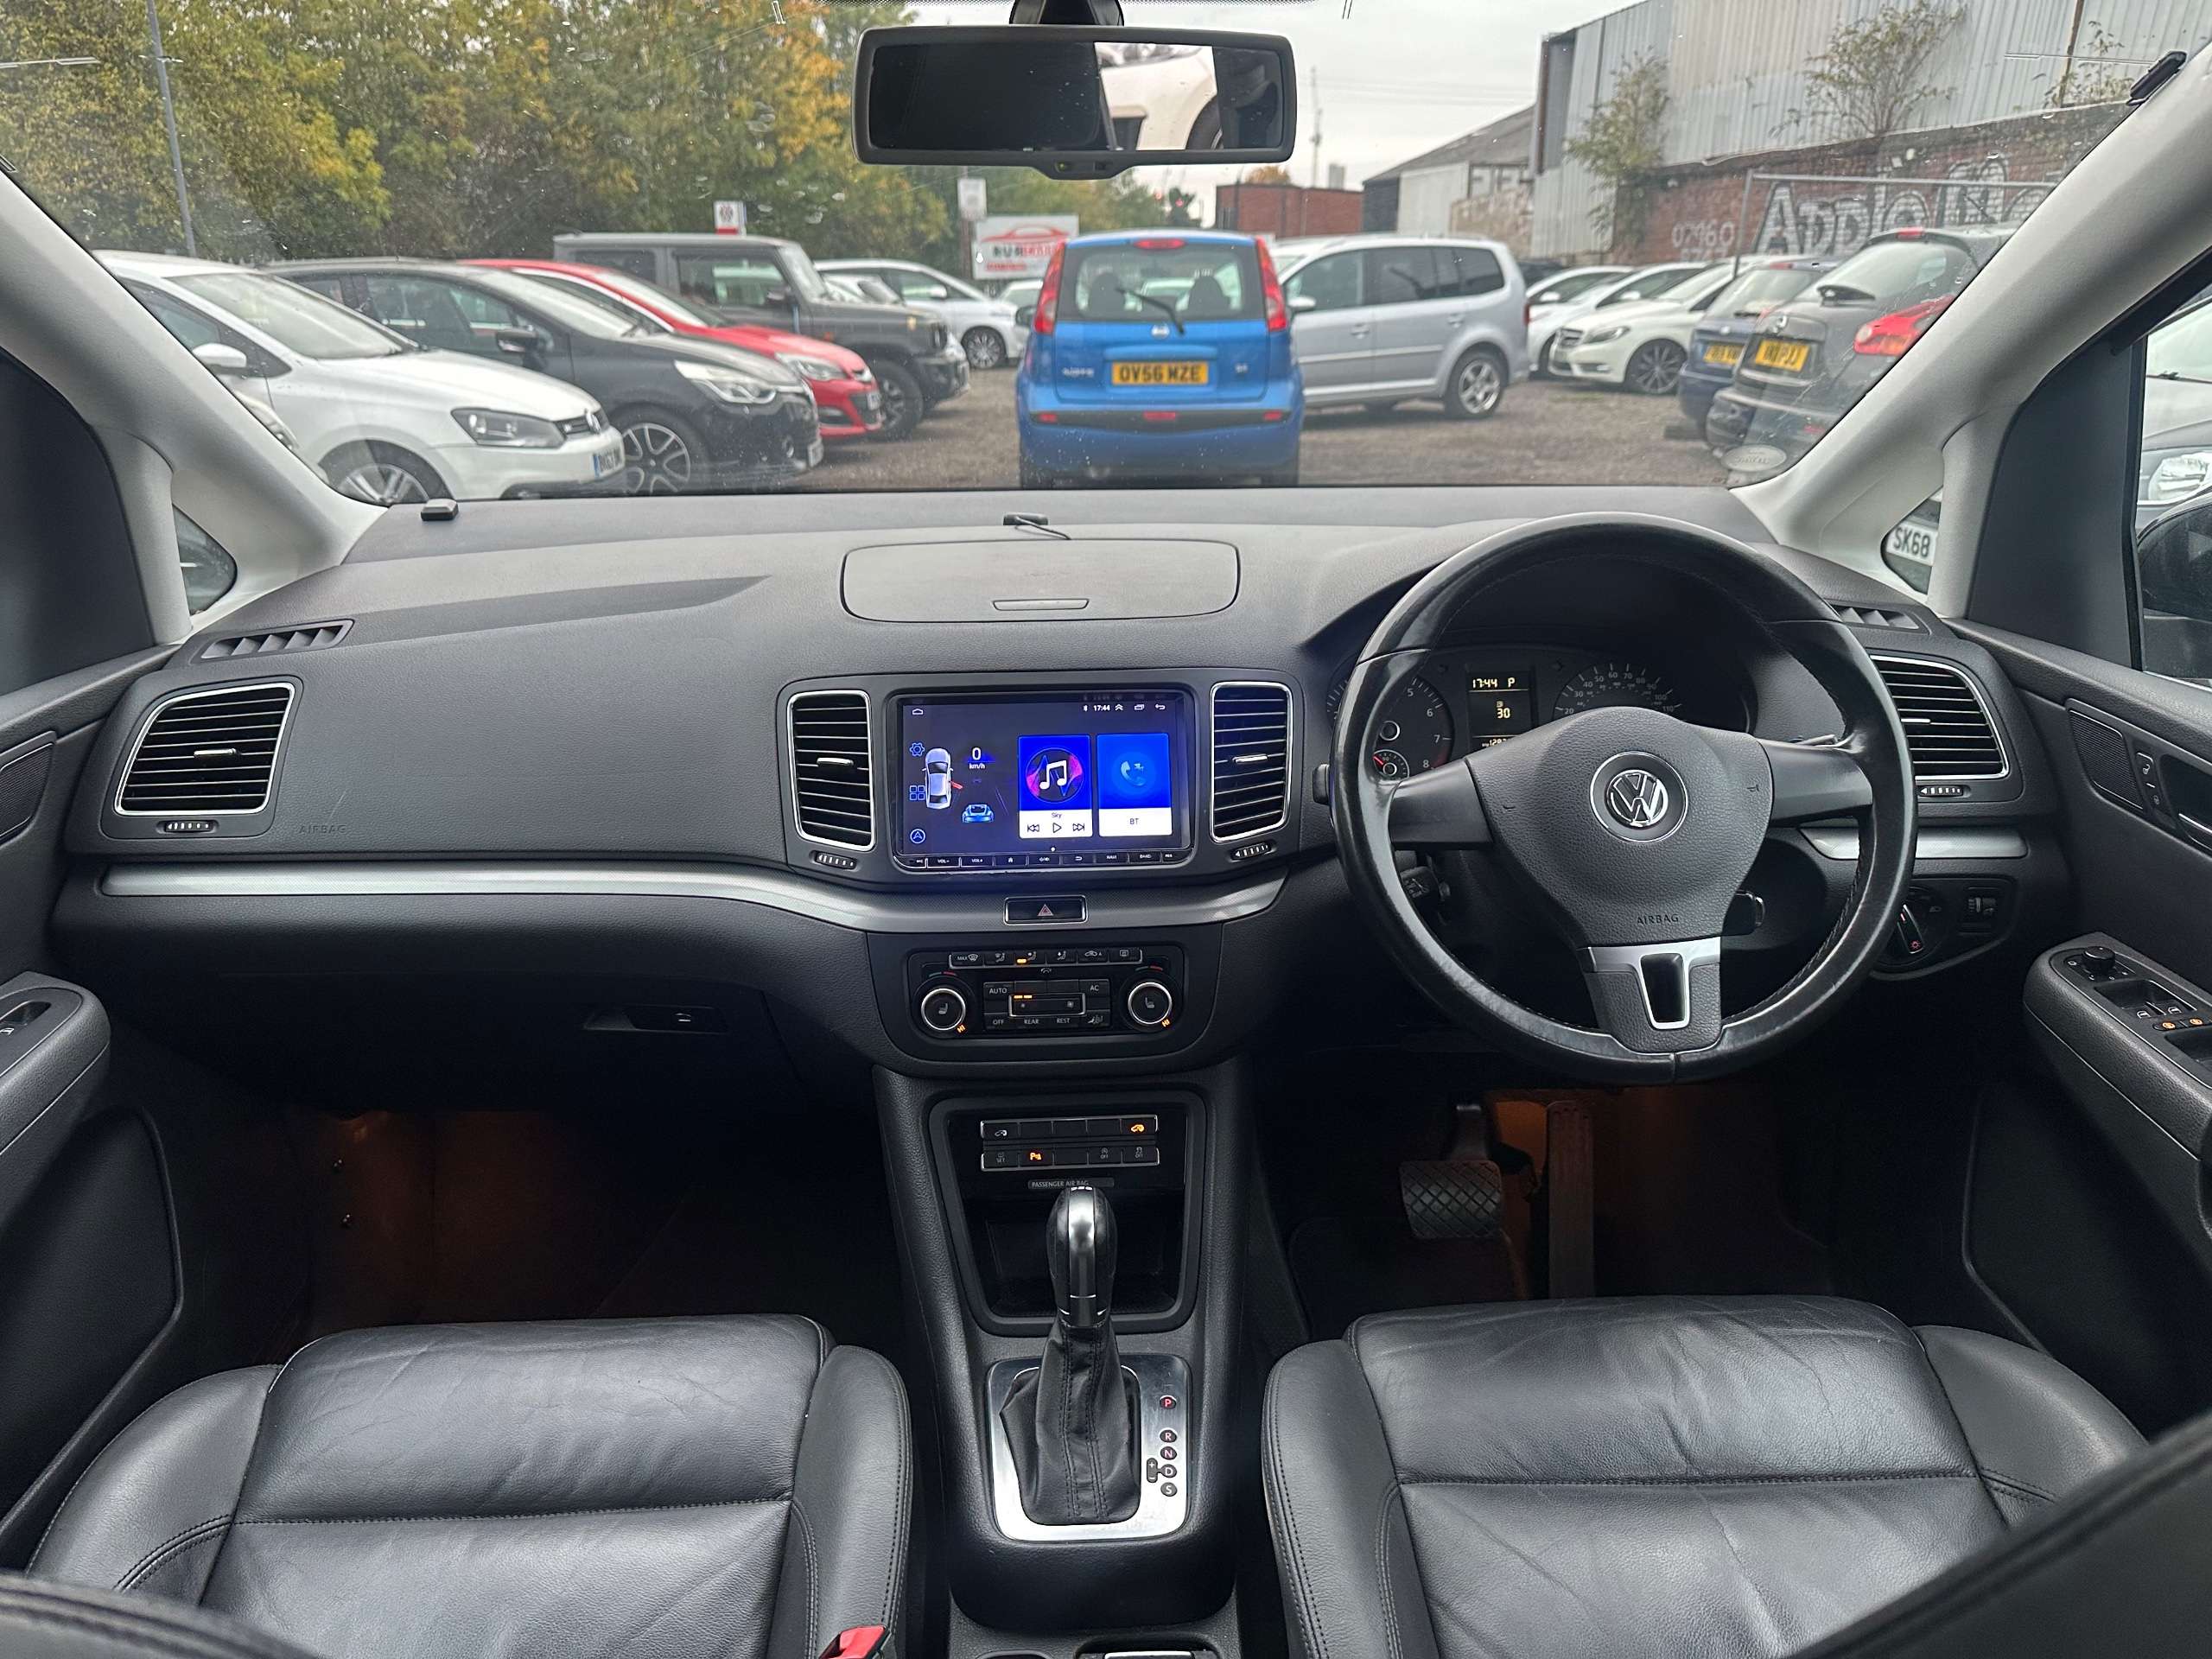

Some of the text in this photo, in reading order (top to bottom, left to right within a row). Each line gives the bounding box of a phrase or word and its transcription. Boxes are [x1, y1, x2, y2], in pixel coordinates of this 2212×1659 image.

[1893, 527, 1930, 558] SK68
[1472, 677, 1516, 689] 17:44 P
[1407, 689, 1414, 697] 5
[1427, 708, 1433, 717] 6
[1497, 708, 1510, 719] 30
[1433, 734, 1440, 743] 7
[972, 747, 982, 760] 0
[1422, 760, 1429, 768] 8
[1637, 913, 1679, 925] AIRBAG
[1164, 1399, 1172, 1408] P
[1165, 1432, 1172, 1440] R
[1164, 1449, 1173, 1458] N
[1165, 1467, 1173, 1476] D
[1166, 1484, 1173, 1495] S
